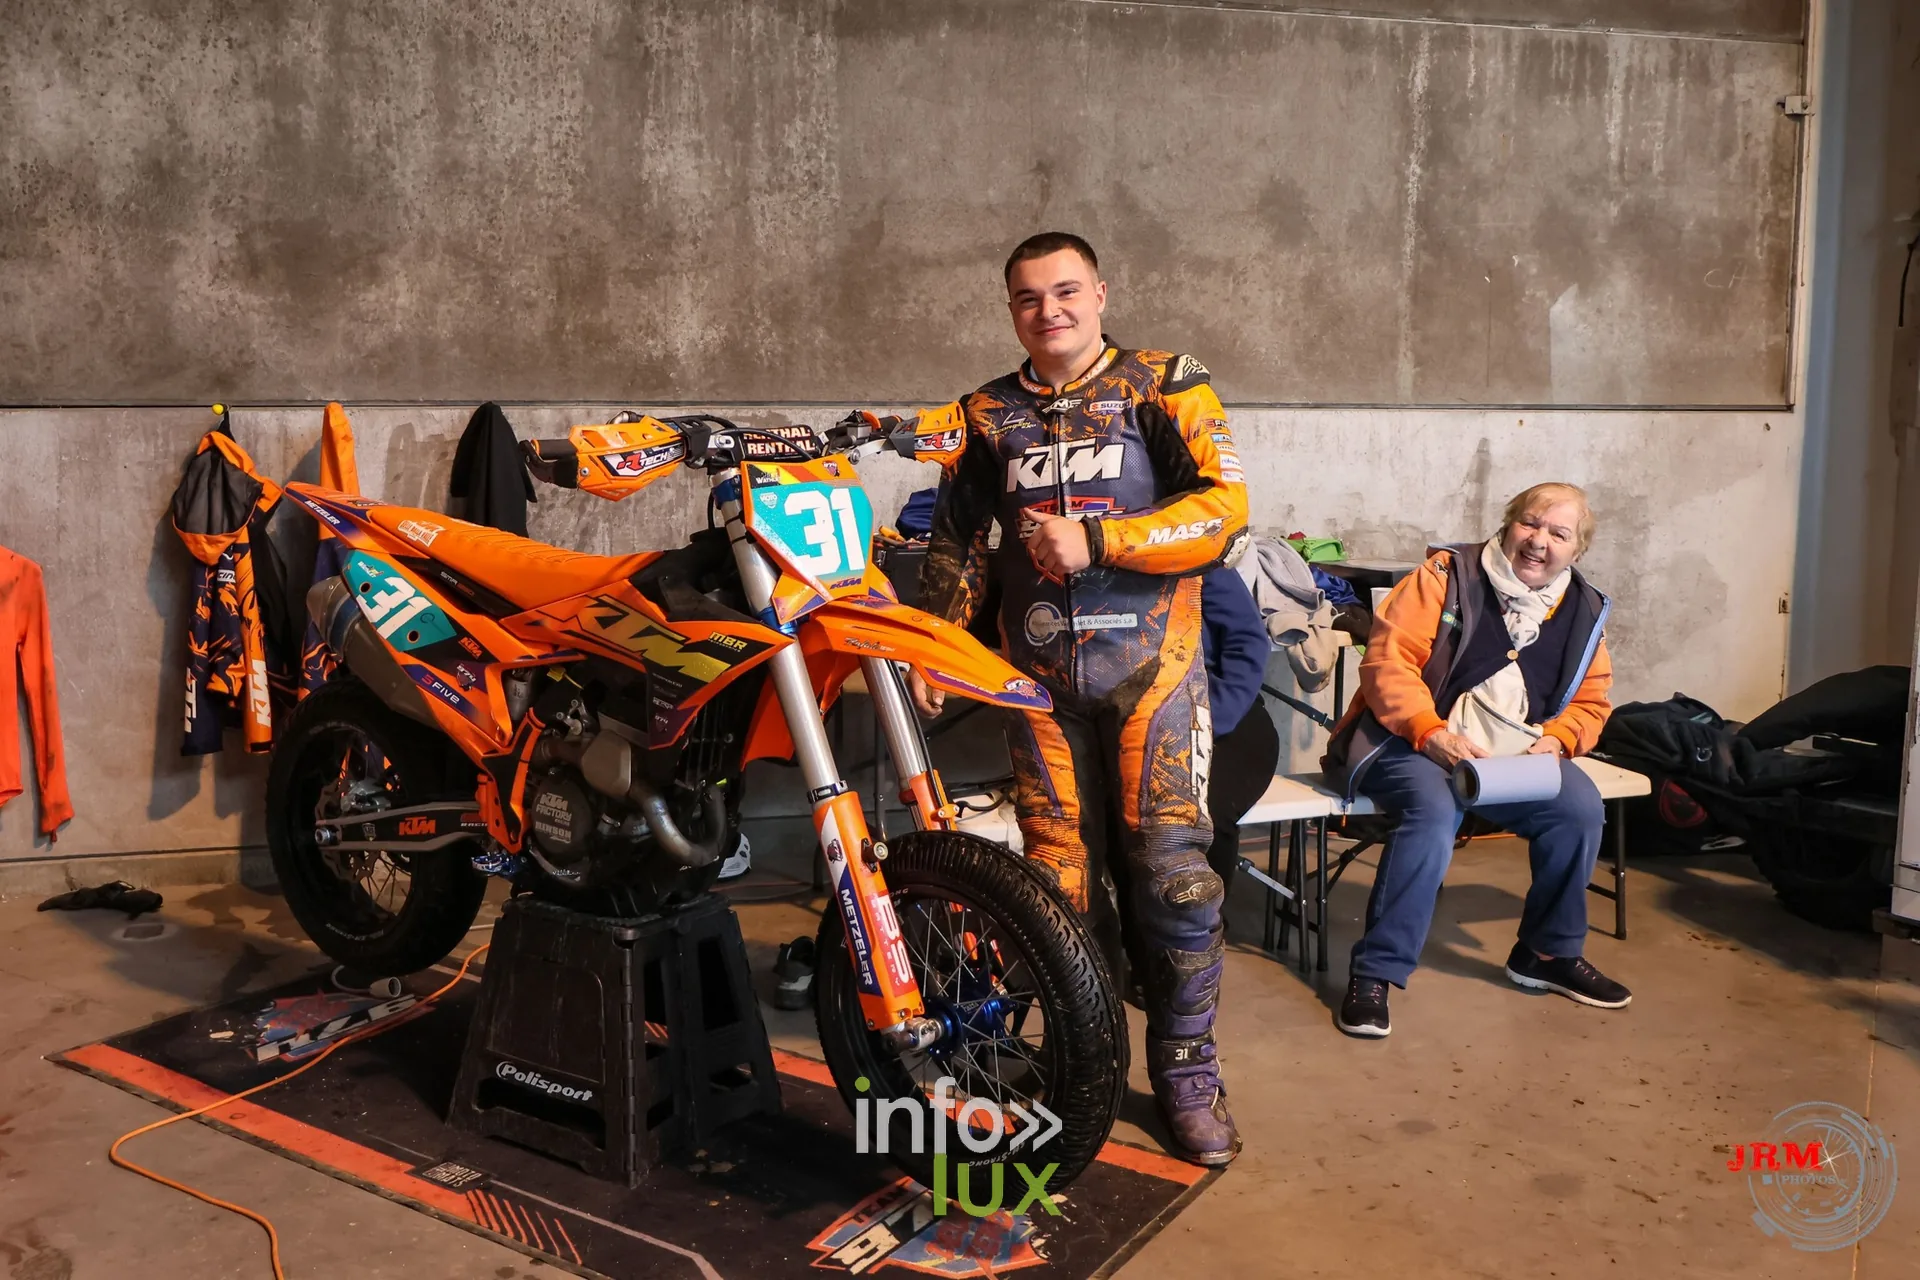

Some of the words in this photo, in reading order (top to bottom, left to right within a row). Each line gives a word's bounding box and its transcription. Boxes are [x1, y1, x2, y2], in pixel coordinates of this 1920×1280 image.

[1006, 438, 1125, 493] KTM
[304, 500, 340, 525] METZELER
[784, 488, 866, 577] 31
[830, 578, 861, 589] KTM
[356, 576, 433, 640] 31
[459, 636, 482, 659] KTM
[577, 593, 732, 684] KTM
[709, 631, 748, 651] MBR
[250, 659, 272, 728] KTM
[536, 804, 572, 822] FACTORY
[540, 793, 569, 811] KTM
[399, 816, 436, 836] KTM
[841, 888, 873, 986] METZELER
[881, 895, 914, 984] BS
[1175, 1048, 1189, 1060] 31
[500, 1062, 593, 1102] Polisport
